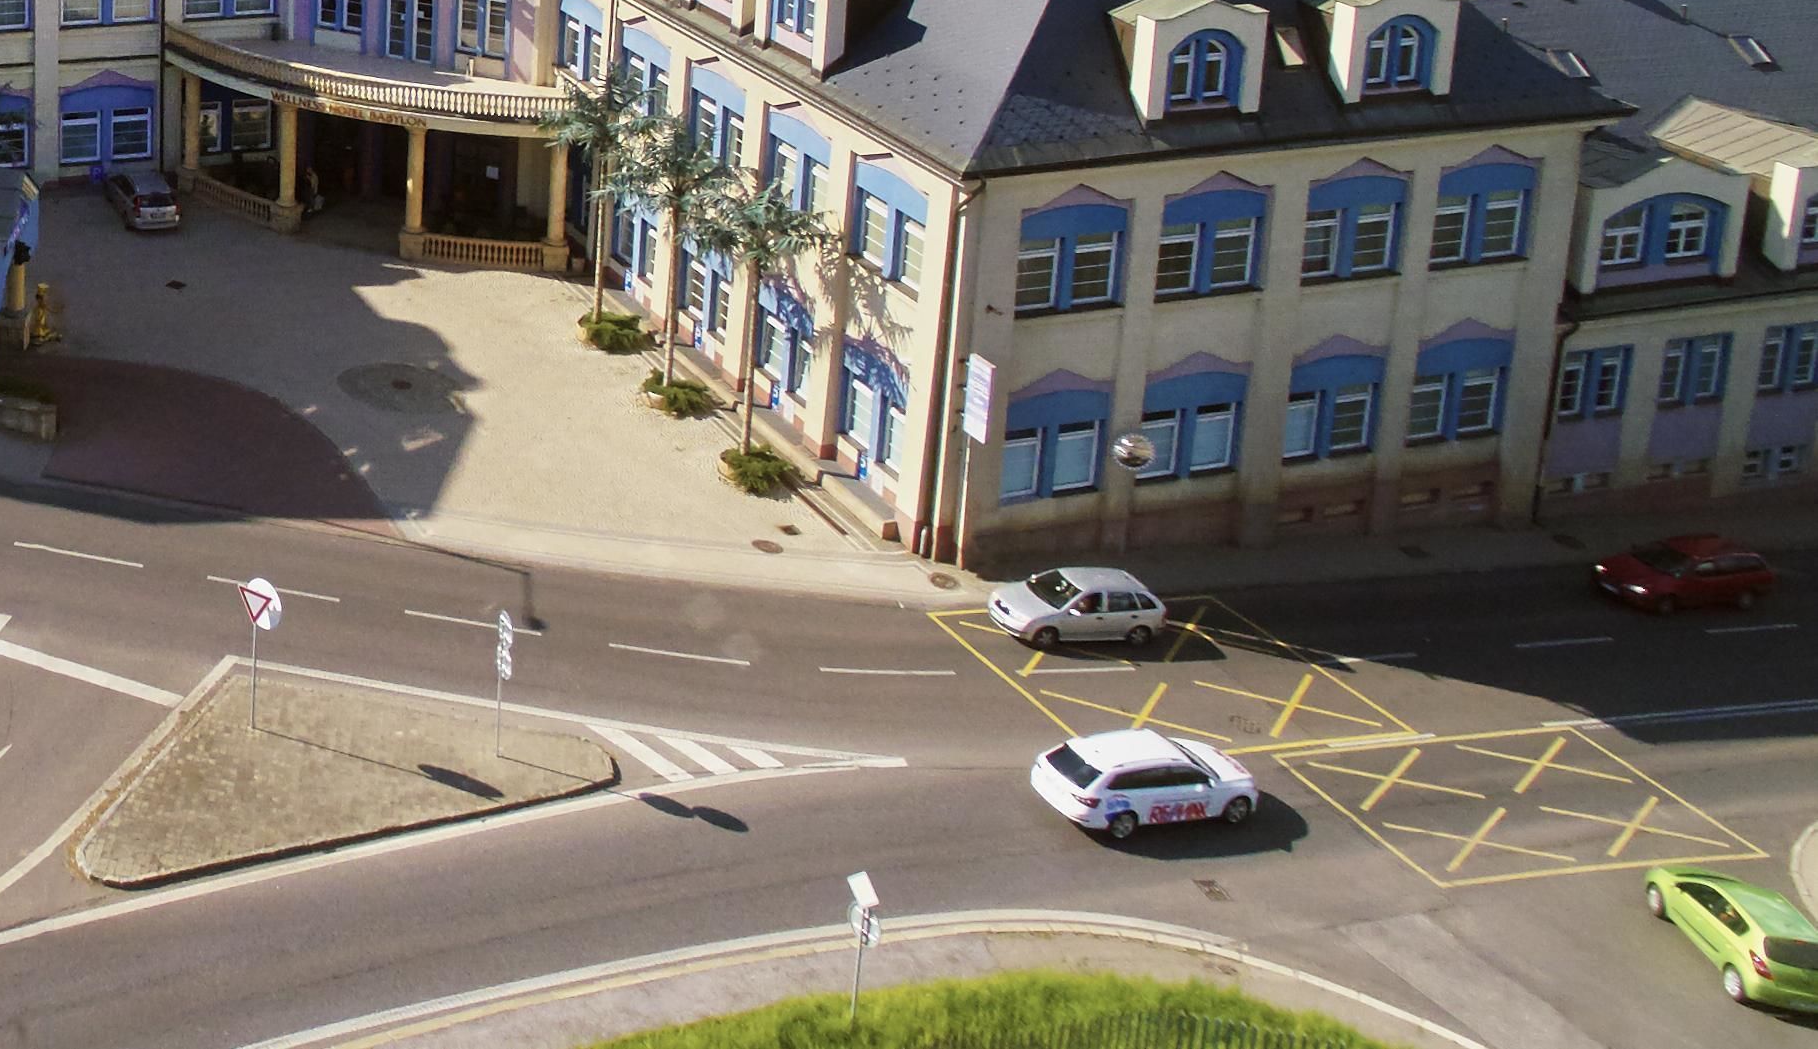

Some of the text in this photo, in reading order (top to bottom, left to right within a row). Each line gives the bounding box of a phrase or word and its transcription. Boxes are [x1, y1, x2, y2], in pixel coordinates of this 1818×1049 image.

[270, 90, 427, 127] WELLNESS HOTEL BABYLON
